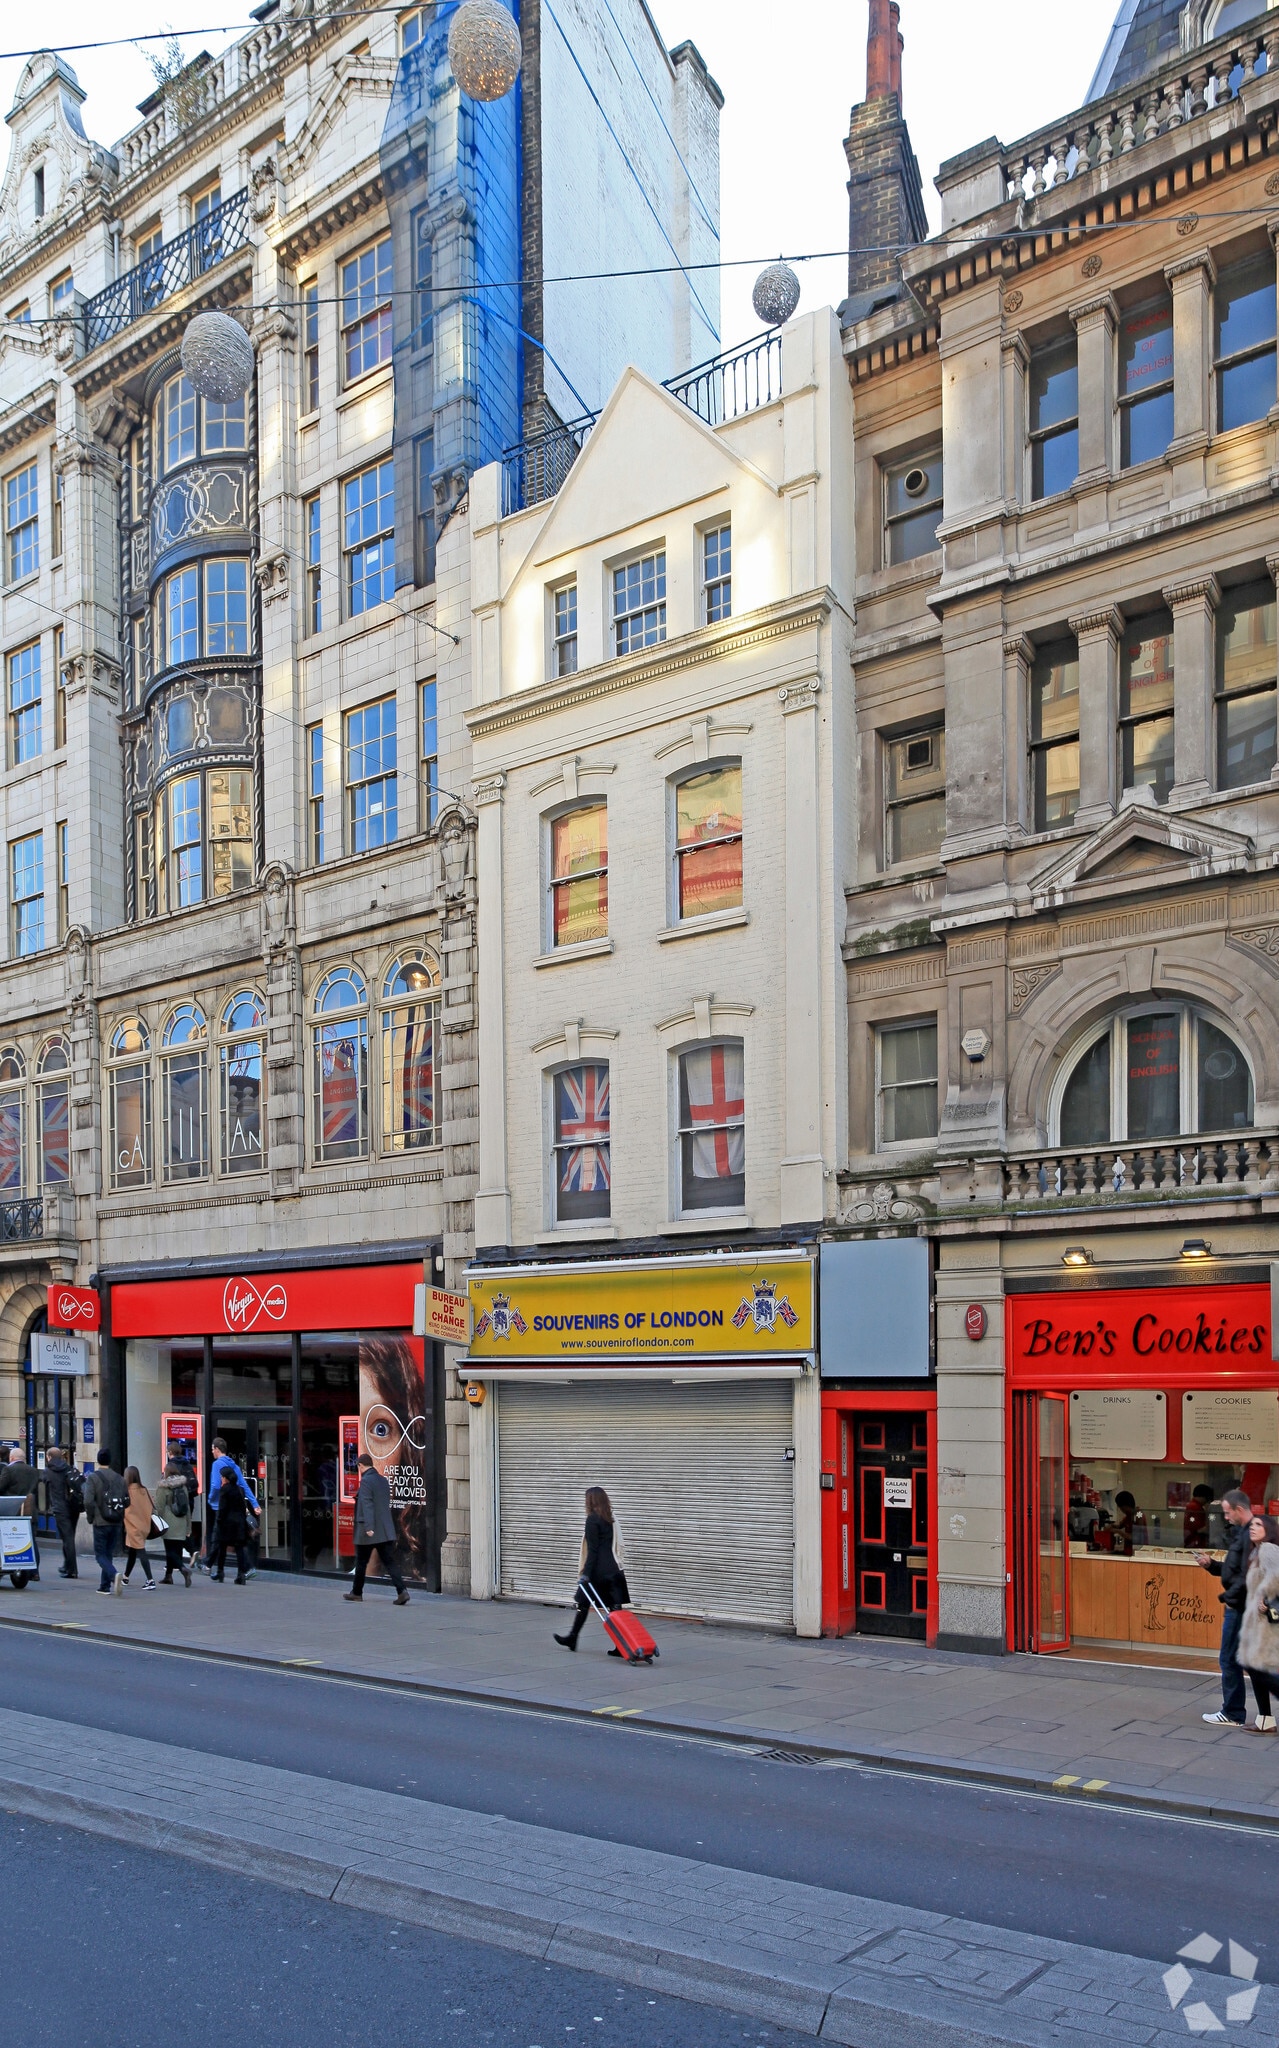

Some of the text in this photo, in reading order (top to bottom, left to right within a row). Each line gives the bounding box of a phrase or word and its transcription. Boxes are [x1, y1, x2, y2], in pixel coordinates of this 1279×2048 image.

[1142, 339, 1156, 352] OF
[1126, 354, 1173, 380] ENGLISH
[1144, 657, 1159, 669] OF
[1127, 672, 1174, 690] ENGLISH
[1132, 1030, 1174, 1043] SCHOOL
[1146, 1049, 1161, 1059] OF
[1130, 1064, 1178, 1078] ENGLISH
[330, 1086, 353, 1096] ENGLISH
[228, 1286, 255, 1322] Virgin
[432, 1291, 465, 1308] BUREAU
[61, 1298, 77, 1316] Virgin
[443, 1304, 455, 1315] DE
[431, 1311, 465, 1328] CHANGE
[533, 1310, 723, 1331] SOUVENIRS OF LONDON
[1023, 1313, 1266, 1357] Ben's Cookies
[561, 1337, 695, 1348] www.souveniroflondon.com
[1103, 1396, 1132, 1404] DRINKS
[1214, 1397, 1252, 1405] COOKIES
[1215, 1433, 1252, 1441] SPECIALS
[383, 1465, 419, 1476] ARE YOU
[411, 1476, 424, 1487] TO
[395, 1486, 427, 1498] MOVED
[1167, 1592, 1203, 1608] Ben's
[1169, 1606, 1216, 1624] Cookies
